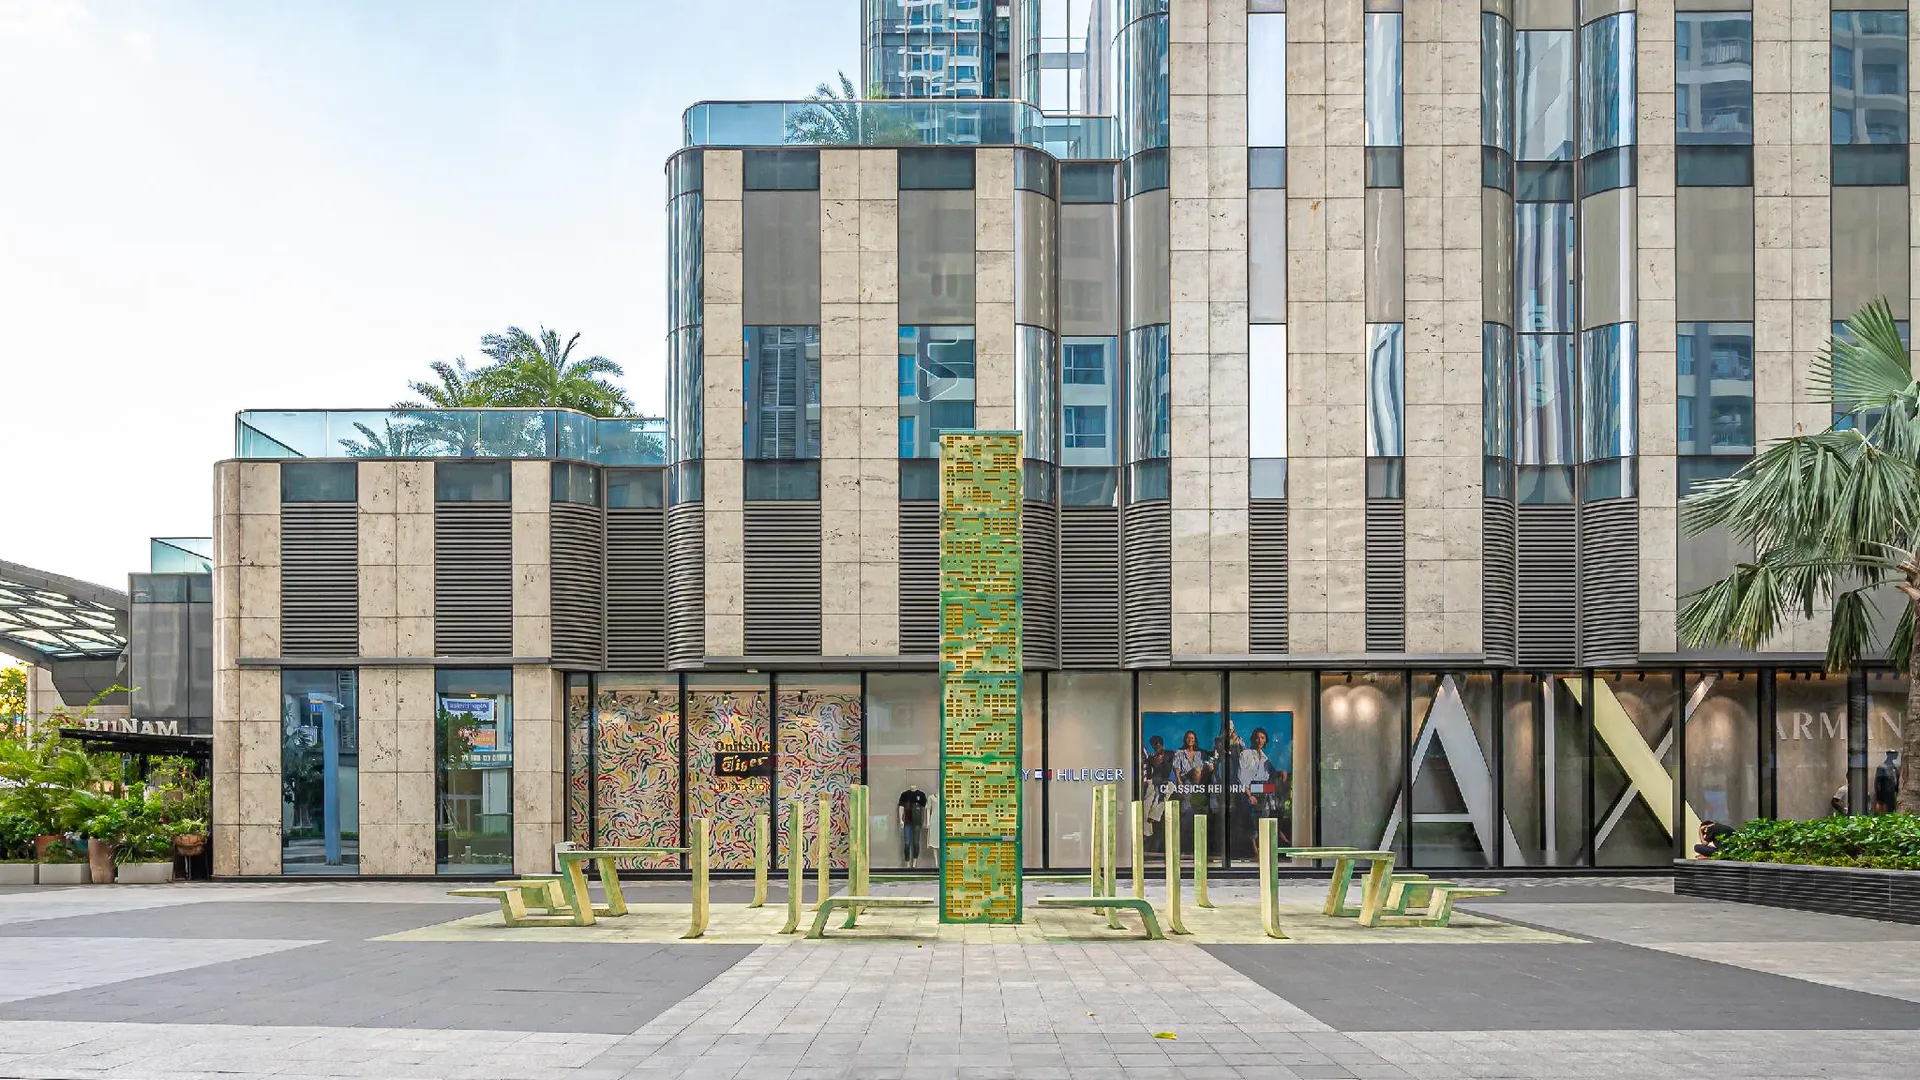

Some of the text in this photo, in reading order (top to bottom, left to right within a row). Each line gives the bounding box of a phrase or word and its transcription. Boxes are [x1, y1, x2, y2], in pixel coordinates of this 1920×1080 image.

[715, 740, 771, 752] Onitsuk
[1057, 768, 1125, 782] HILFIGER
[1160, 783, 1246, 795] CLASSICS RERN
